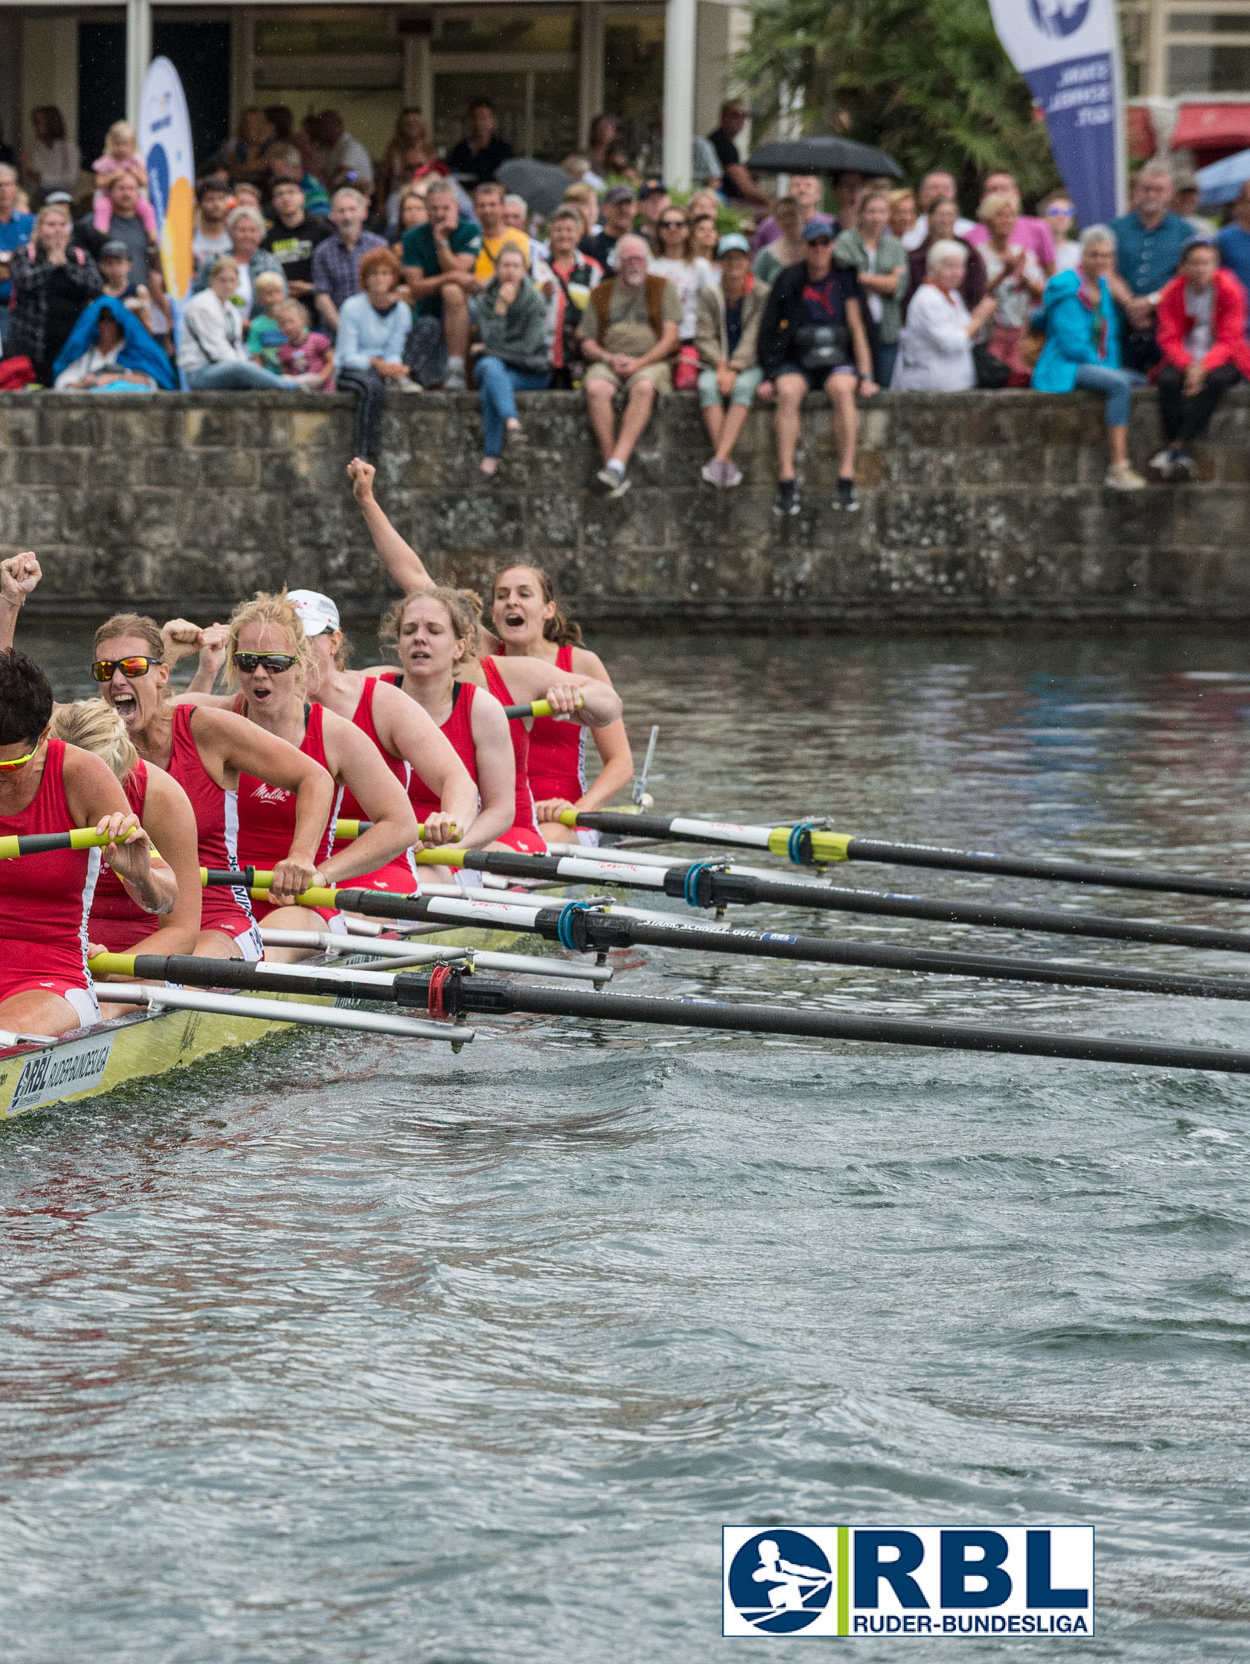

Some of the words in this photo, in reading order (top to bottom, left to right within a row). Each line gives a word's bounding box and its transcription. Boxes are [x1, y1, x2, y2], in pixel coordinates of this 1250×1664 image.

[250, 783, 287, 802] Melitta
[25, 1056, 52, 1095] RBL
[46, 1046, 110, 1089] RUDER-BUNDESLIGA
